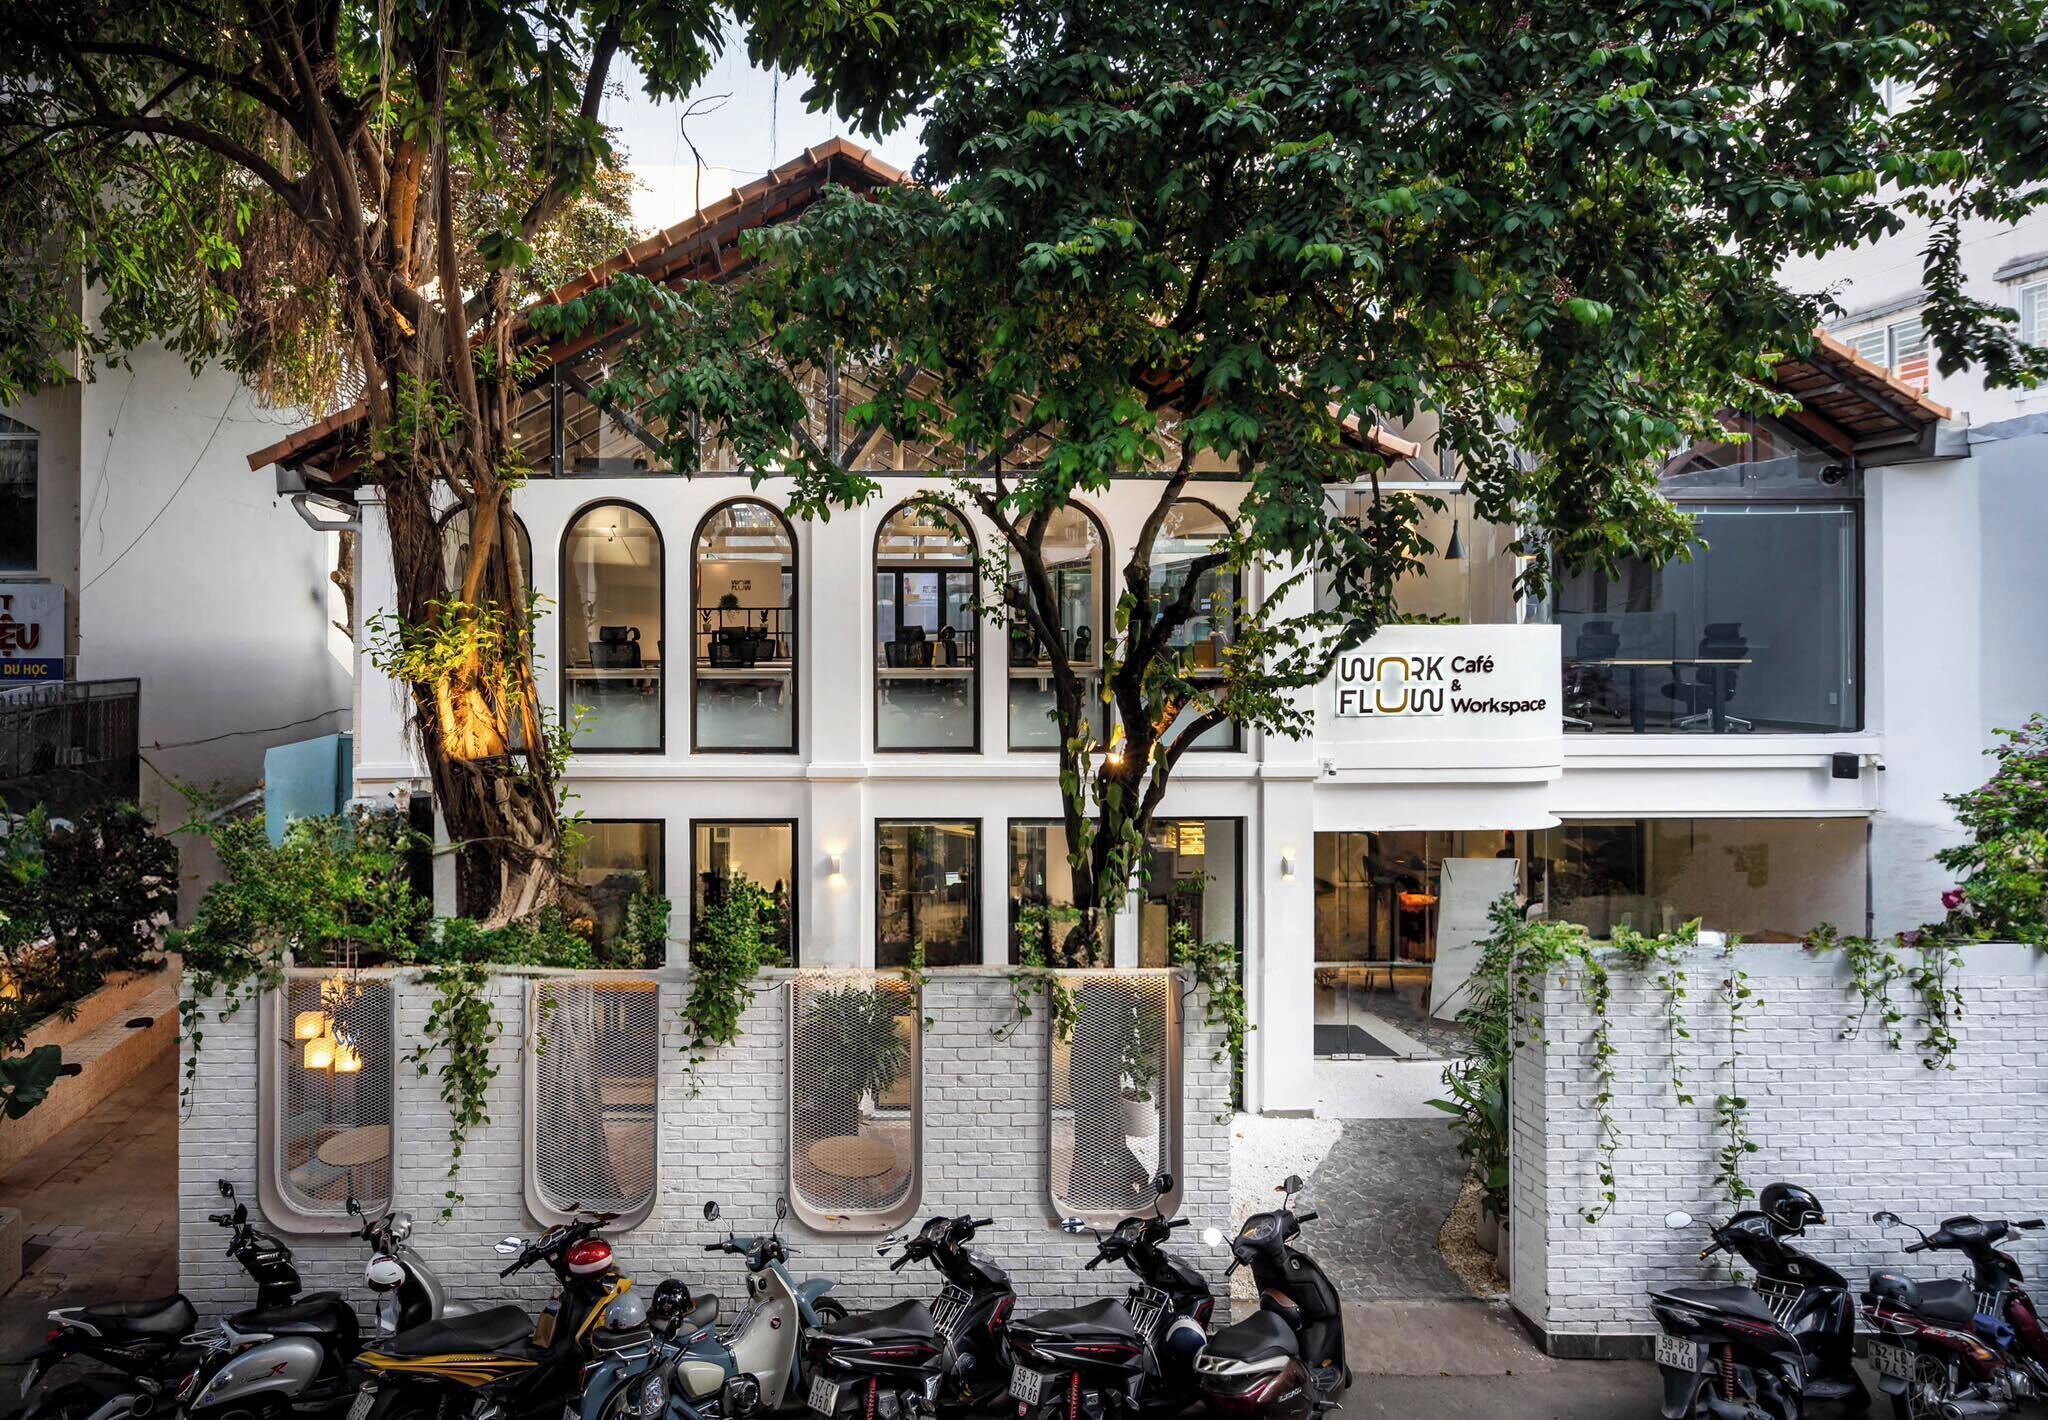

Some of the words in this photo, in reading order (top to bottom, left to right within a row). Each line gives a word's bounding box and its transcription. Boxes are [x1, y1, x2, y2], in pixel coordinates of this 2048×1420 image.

[3, 664, 21, 676] DU
[23, 664, 48, 678] HỌC
[1341, 656, 1445, 682] WORK
[1451, 655, 1494, 673] Café
[1451, 679, 1462, 692] &
[1340, 688, 1444, 714] FLOW
[1451, 697, 1546, 716] Workspace
[1662, 1337, 1690, 1356] 59-P2
[1658, 1349, 1694, 1369] 238.40
[1017, 1368, 1038, 1388] 59-T2
[1011, 1381, 1038, 1403] 320.86
